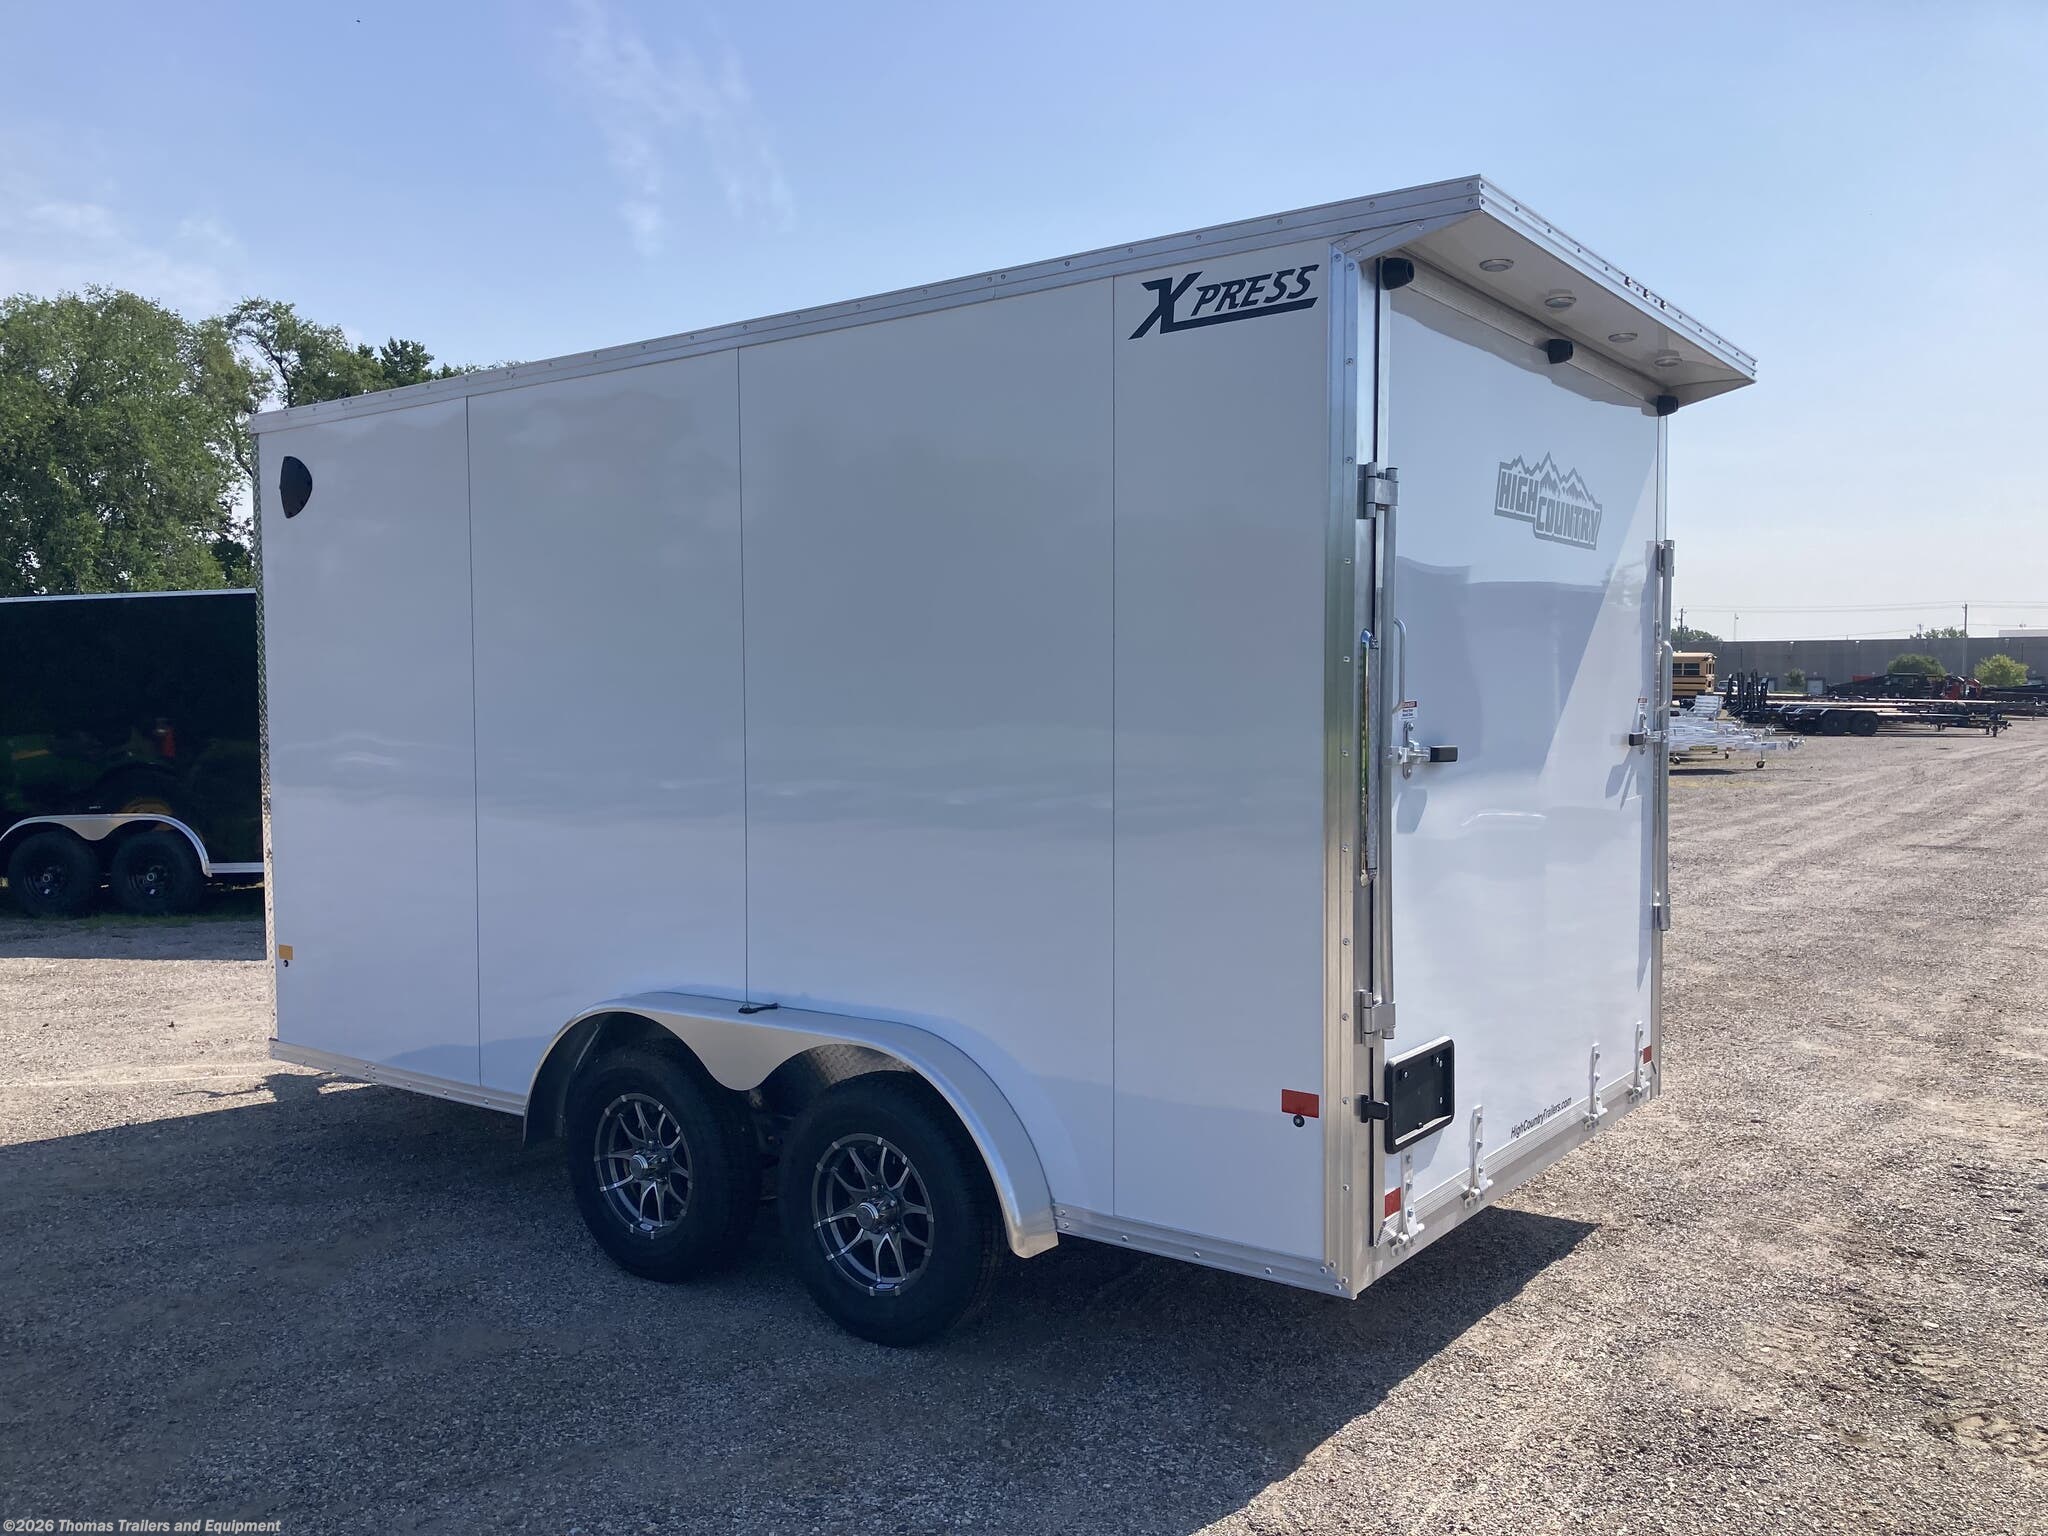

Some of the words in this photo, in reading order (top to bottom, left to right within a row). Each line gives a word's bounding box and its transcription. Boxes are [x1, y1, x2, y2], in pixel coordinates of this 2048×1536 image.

[1128, 264, 1320, 340] XPRESS
[1498, 470, 1539, 516] HIGH
[1535, 496, 1600, 544] COUNTRY
[1510, 1097, 1571, 1139] HighCountryTrailers.com
